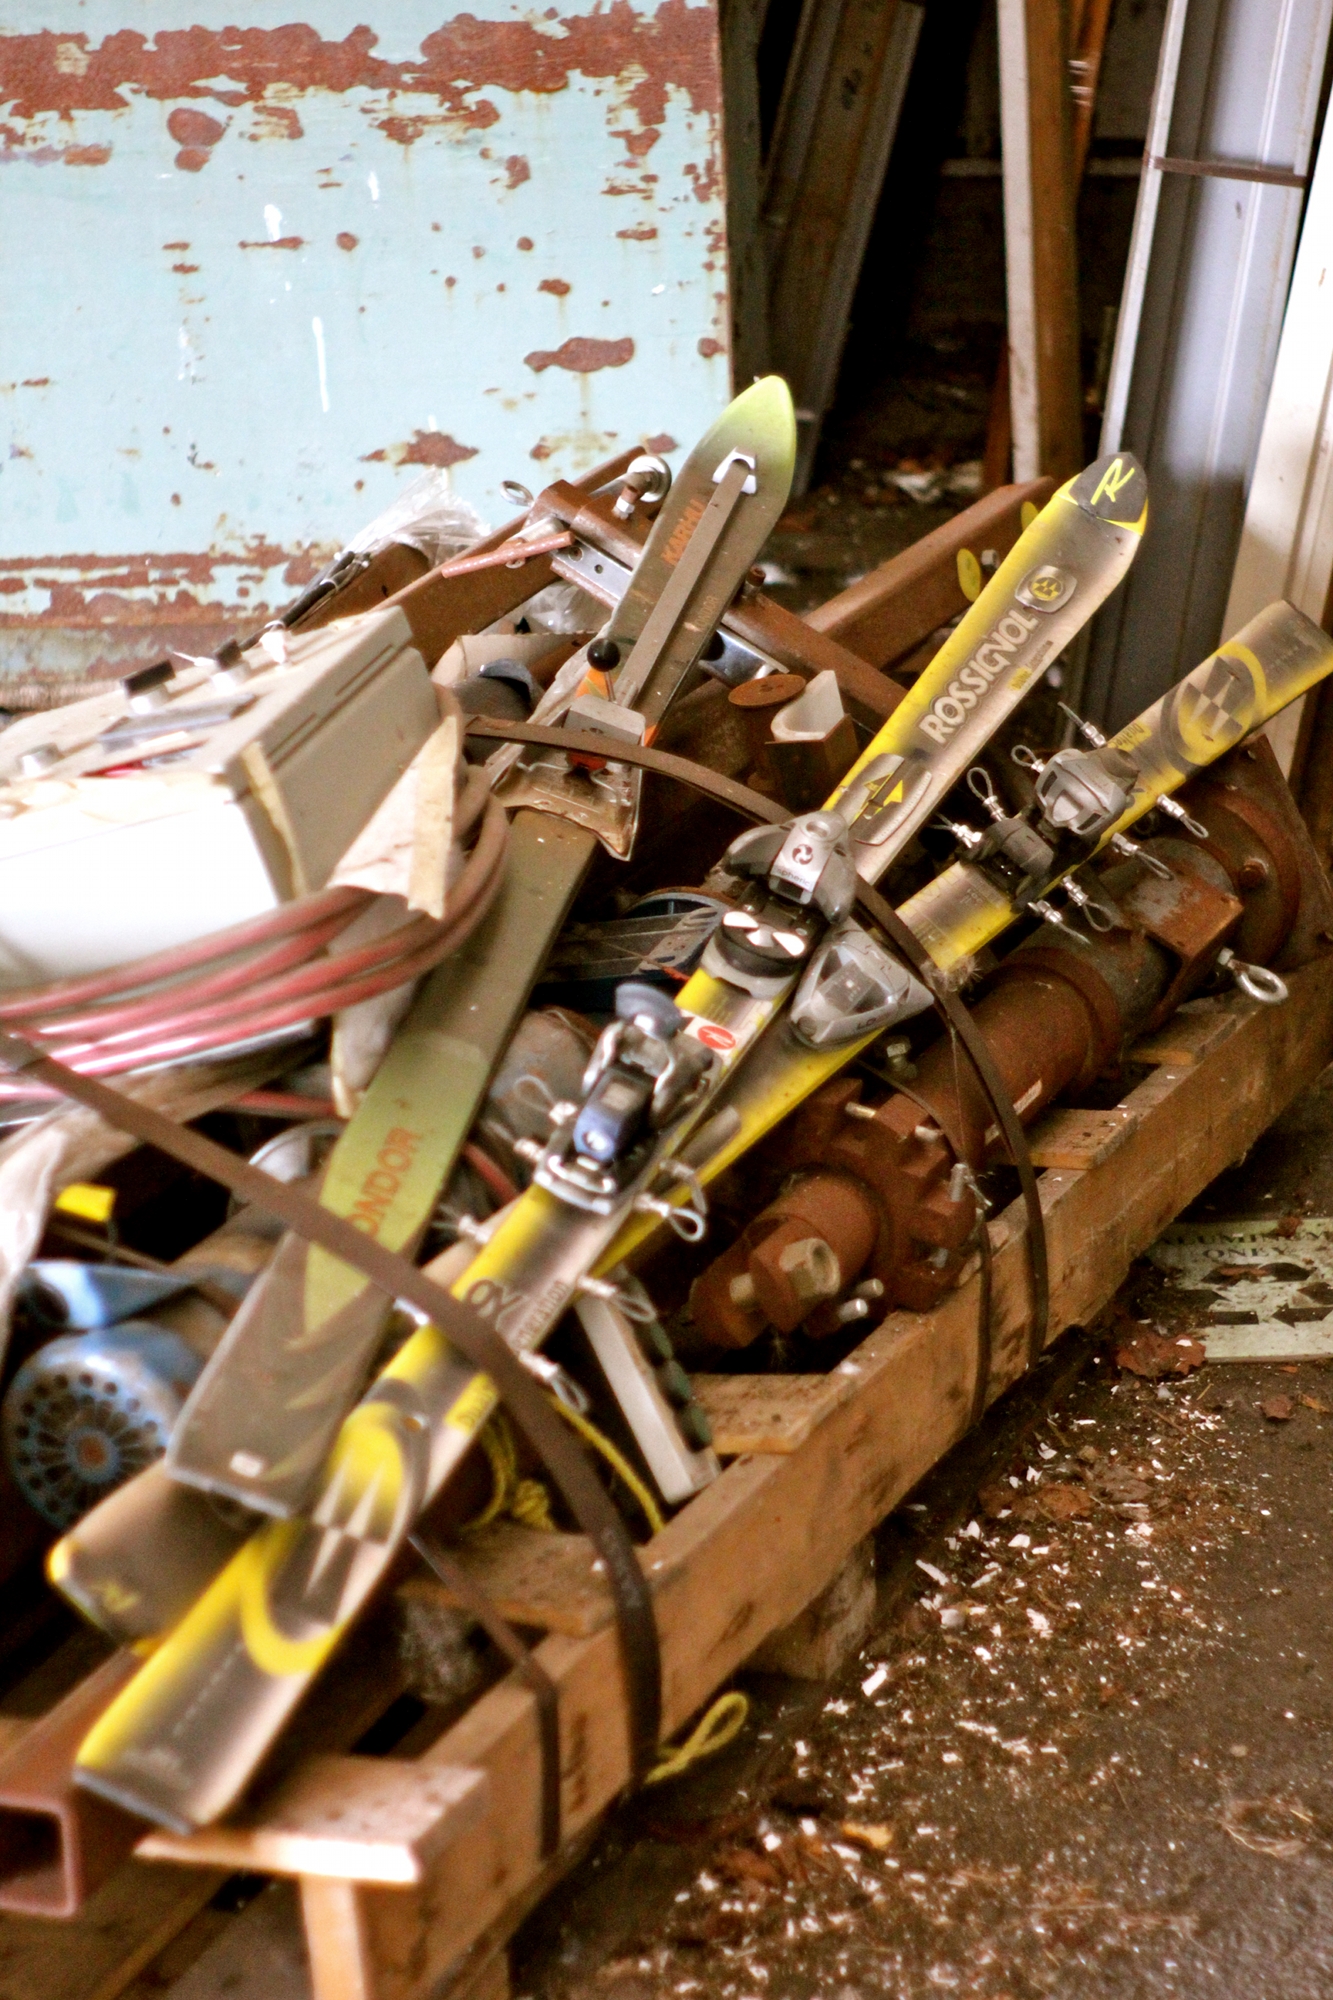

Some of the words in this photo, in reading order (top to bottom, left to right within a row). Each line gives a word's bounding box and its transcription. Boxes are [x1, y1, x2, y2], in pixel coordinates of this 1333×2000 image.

[660, 497, 707, 567] KARHU
[917, 609, 1040, 745] ROSSIGNOL
[343, 1125, 424, 1238] ONDOR
